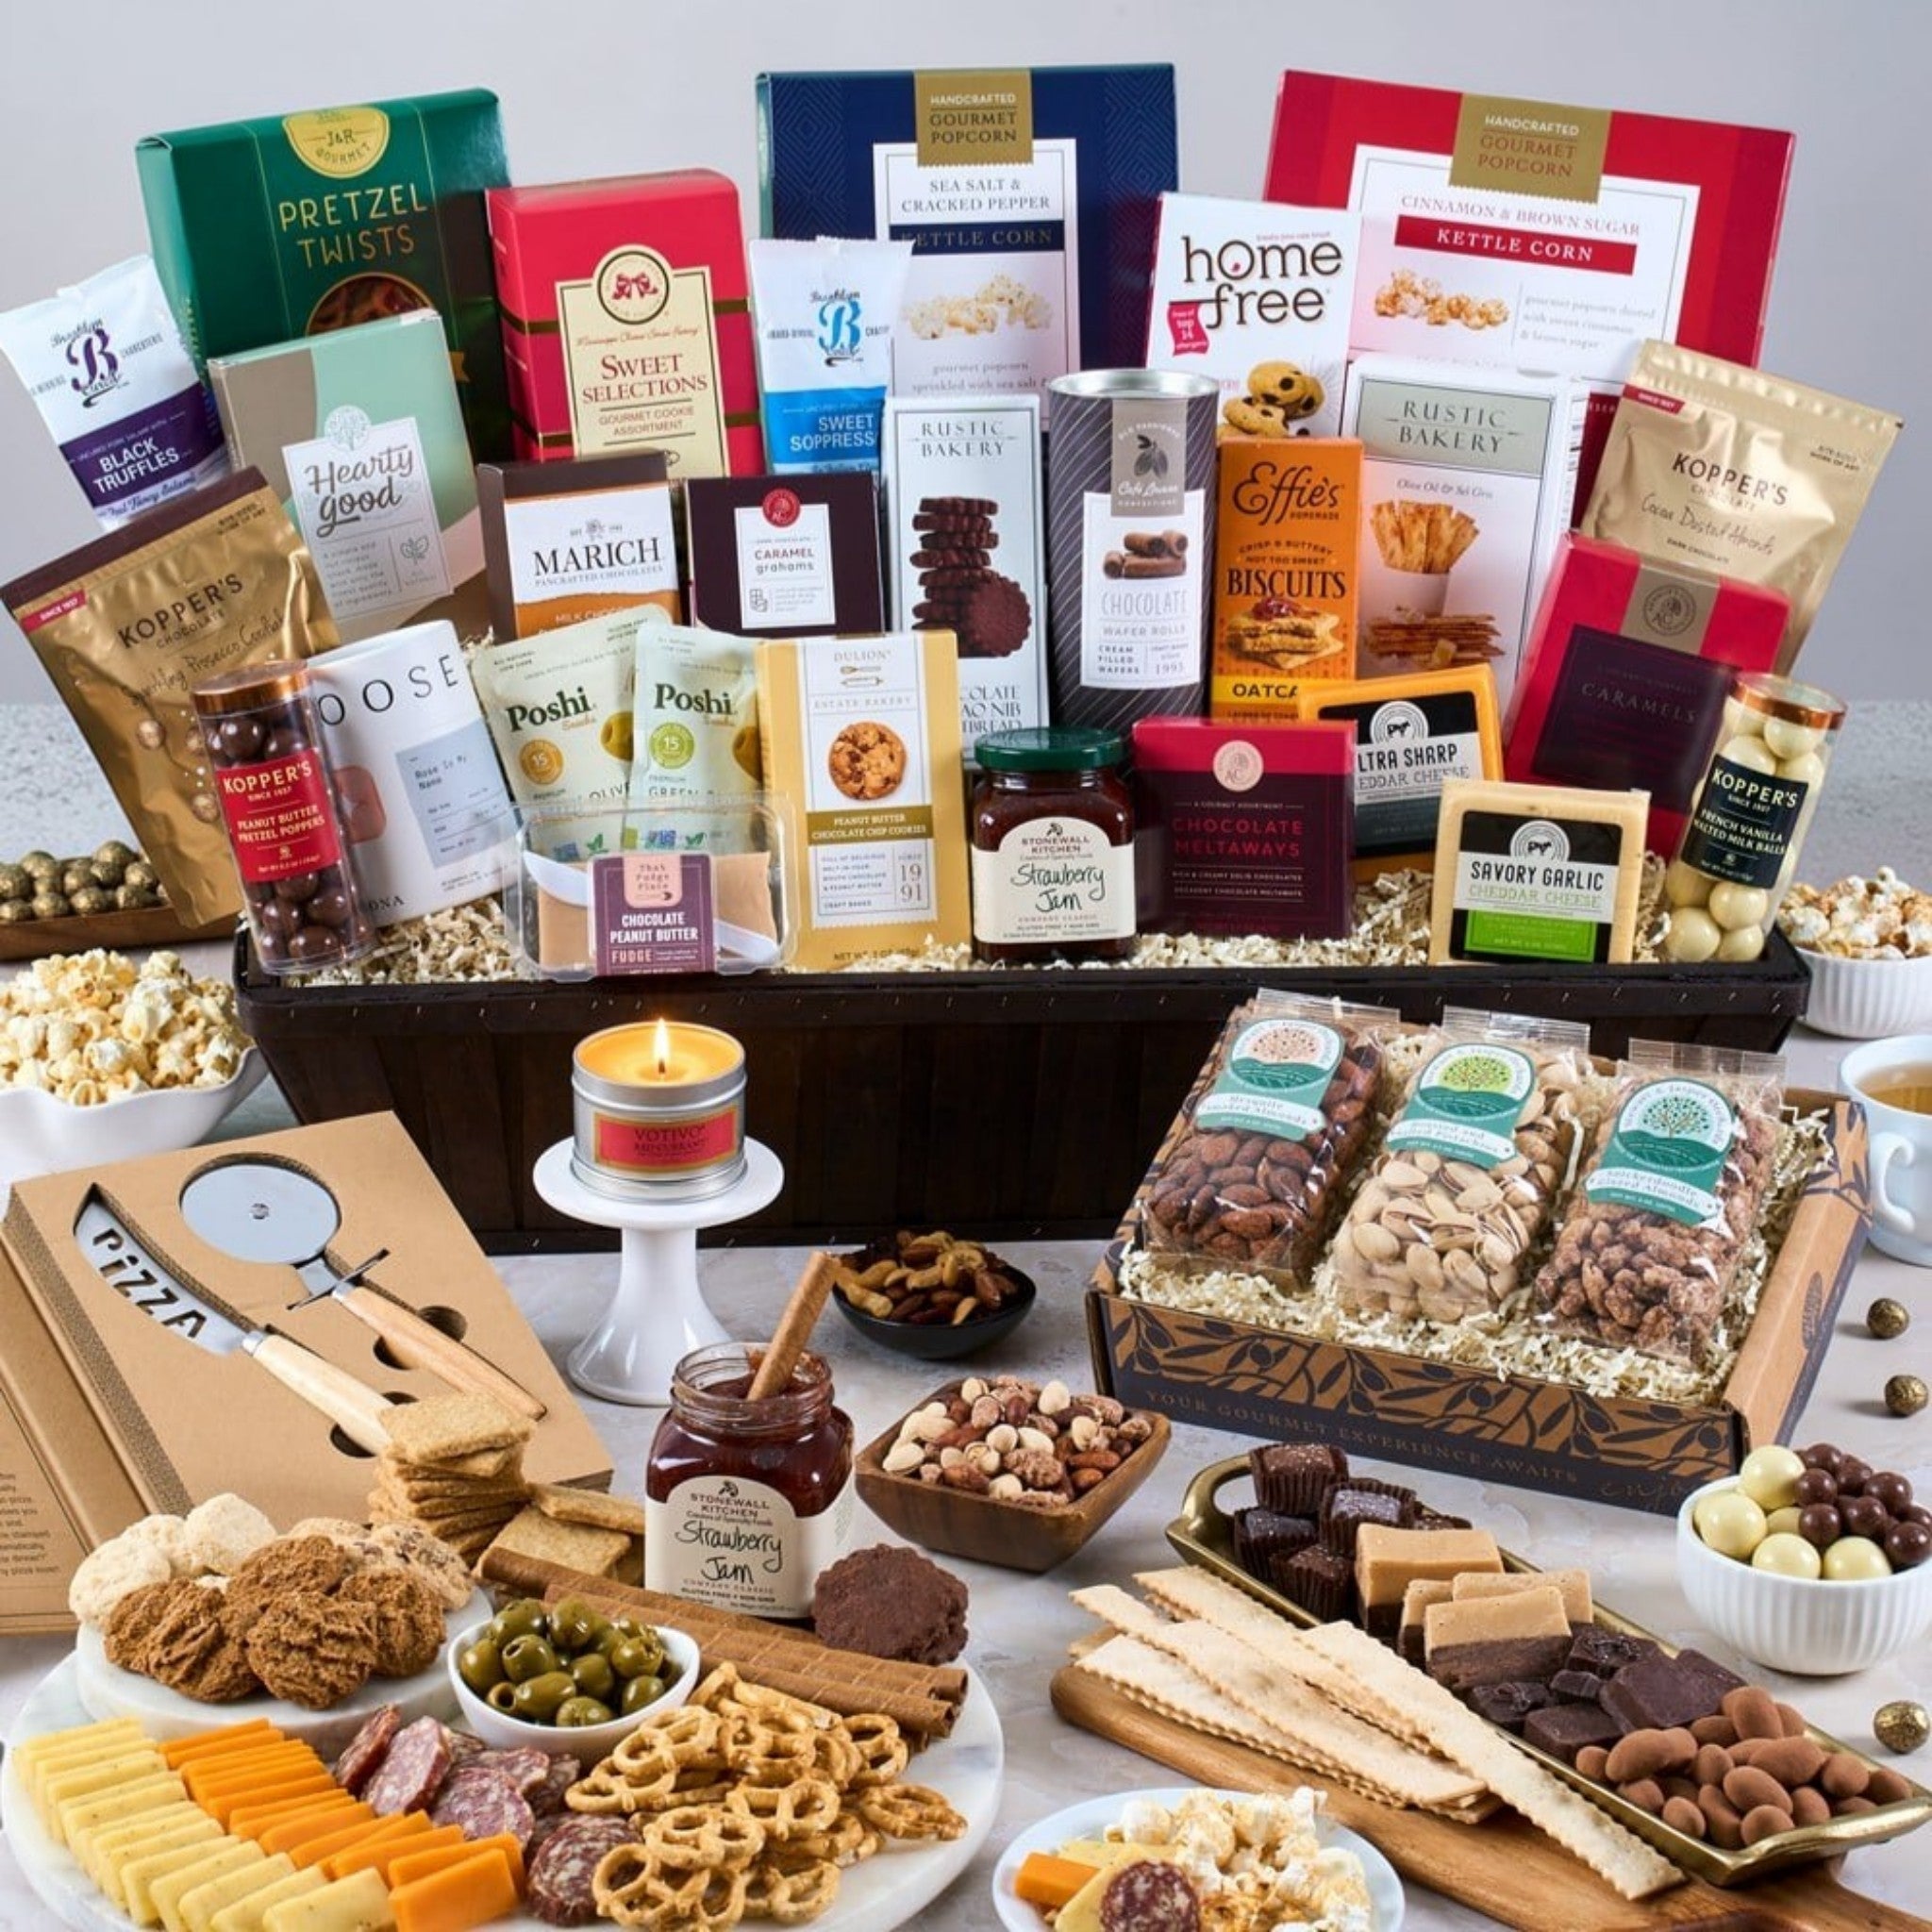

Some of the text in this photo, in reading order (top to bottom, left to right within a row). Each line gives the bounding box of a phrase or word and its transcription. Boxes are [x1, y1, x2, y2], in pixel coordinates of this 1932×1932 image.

[930, 92, 1017, 107] HANDCRAFTED
[929, 110, 1018, 128] GOURMET
[1484, 114, 1580, 137] HANDCRAFTED
[326, 129, 355, 146] J&R
[930, 129, 1017, 144] POPCORN
[1480, 134, 1578, 159] GOURMET
[1477, 153, 1574, 177] POPCORN
[929, 177, 1021, 193] SEA SALT &
[278, 183, 427, 232] PRETZEL
[902, 194, 1050, 214] CRACKED PEPPER
[1401, 194, 1641, 237] CINNAMON & BROWN SUGAR
[297, 224, 415, 268] TWISTS
[992, 228, 1053, 246] CORN
[1437, 227, 1593, 262] KETTLE CORN
[1181, 235, 1343, 283] home
[1169, 282, 1325, 330] free
[601, 353, 683, 381] SWEET
[582, 375, 708, 406] SELECTIONS
[970, 377, 993, 391] with
[996, 380, 1014, 390] sea
[1016, 375, 1037, 389] salt
[598, 406, 695, 426] GOURMET COOKIE
[819, 413, 874, 432] SWEET
[1402, 400, 1507, 428] RUSTIC
[613, 420, 684, 437] ASSORTMENT
[922, 421, 1005, 436] RUSTIC
[790, 431, 878, 453] SOPPRESS
[921, 441, 1005, 458] BAKERY
[1399, 425, 1505, 454] BAKERY
[99, 437, 159, 473] BLACK
[92, 446, 179, 494] TRUFFLES
[305, 443, 413, 494] Hearty
[1672, 452, 1789, 506] KOPPER'S
[1232, 461, 1341, 526] Effie's
[1397, 478, 1421, 491] Olive
[1424, 481, 1438, 492] Oil
[316, 475, 403, 538] good
[533, 537, 660, 576] MARICH
[755, 548, 815, 560] CARAMEL
[1239, 541, 1334, 555] CRISP BUTTERY
[756, 560, 815, 575] grahams
[1292, 557, 1326, 565] SWEET
[600, 566, 663, 581] CHOCOLATES
[1226, 568, 1347, 599] BISCUITS
[117, 572, 244, 649] KOPPER'S
[1101, 589, 1189, 615] CHOCOLATE
[156, 609, 226, 650] CHOCOLATE
[1103, 625, 1186, 636] WAFER ROLLS
[1098, 644, 1134, 653] CREAM
[1097, 665, 1140, 675] WAFERS
[1098, 656, 1134, 664] FILLED
[506, 686, 592, 733] Poshi
[655, 682, 733, 716] Poshi
[865, 696, 912, 708] BAKERY
[991, 701, 1022, 717] NIB
[1580, 682, 1698, 724] CARAMELS
[663, 737, 680, 751] 15
[1404, 743, 1458, 769] SHARP
[223, 760, 312, 794] KOPPER'S
[1710, 768, 1799, 808] KOPPER'S
[237, 805, 320, 830] PEANUT BUTTER
[834, 813, 907, 826] PEANUT BUTTER
[1173, 818, 1304, 836] CHOCOLATE
[1700, 808, 1784, 843] FRENCH VANILLA
[238, 815, 325, 843] PRETZEL POPPERS
[811, 824, 927, 841] CHOCOLATE CHIP COOKIES
[1021, 836, 1091, 846] STONEWALL
[1031, 845, 1081, 854] KITCHEN
[1174, 841, 1301, 858] MELTAWAYS
[1727, 831, 1754, 851] MILK
[900, 863, 922, 883] 19
[1010, 862, 1106, 901] Strawberry
[1471, 860, 1606, 892] SAVORY GARLIC
[900, 883, 923, 904] 91
[1035, 888, 1083, 912] Jam
[1469, 885, 1603, 909] CHEDDAR CHEESE
[622, 911, 686, 927] CHOCOLATE
[609, 926, 698, 943] PEANUT BUTTER
[611, 948, 653, 964] FUDGE
[634, 1125, 700, 1143] VOTIVO
[1145, 1390, 1579, 1484] YOUR GOURMET EXPERIENCE AWAITS
[691, 1492, 771, 1510] STONEWALL
[701, 1505, 758, 1519] KITCHEN
[675, 1519, 783, 1574] Strawberry
[701, 1557, 755, 1585] Jam
